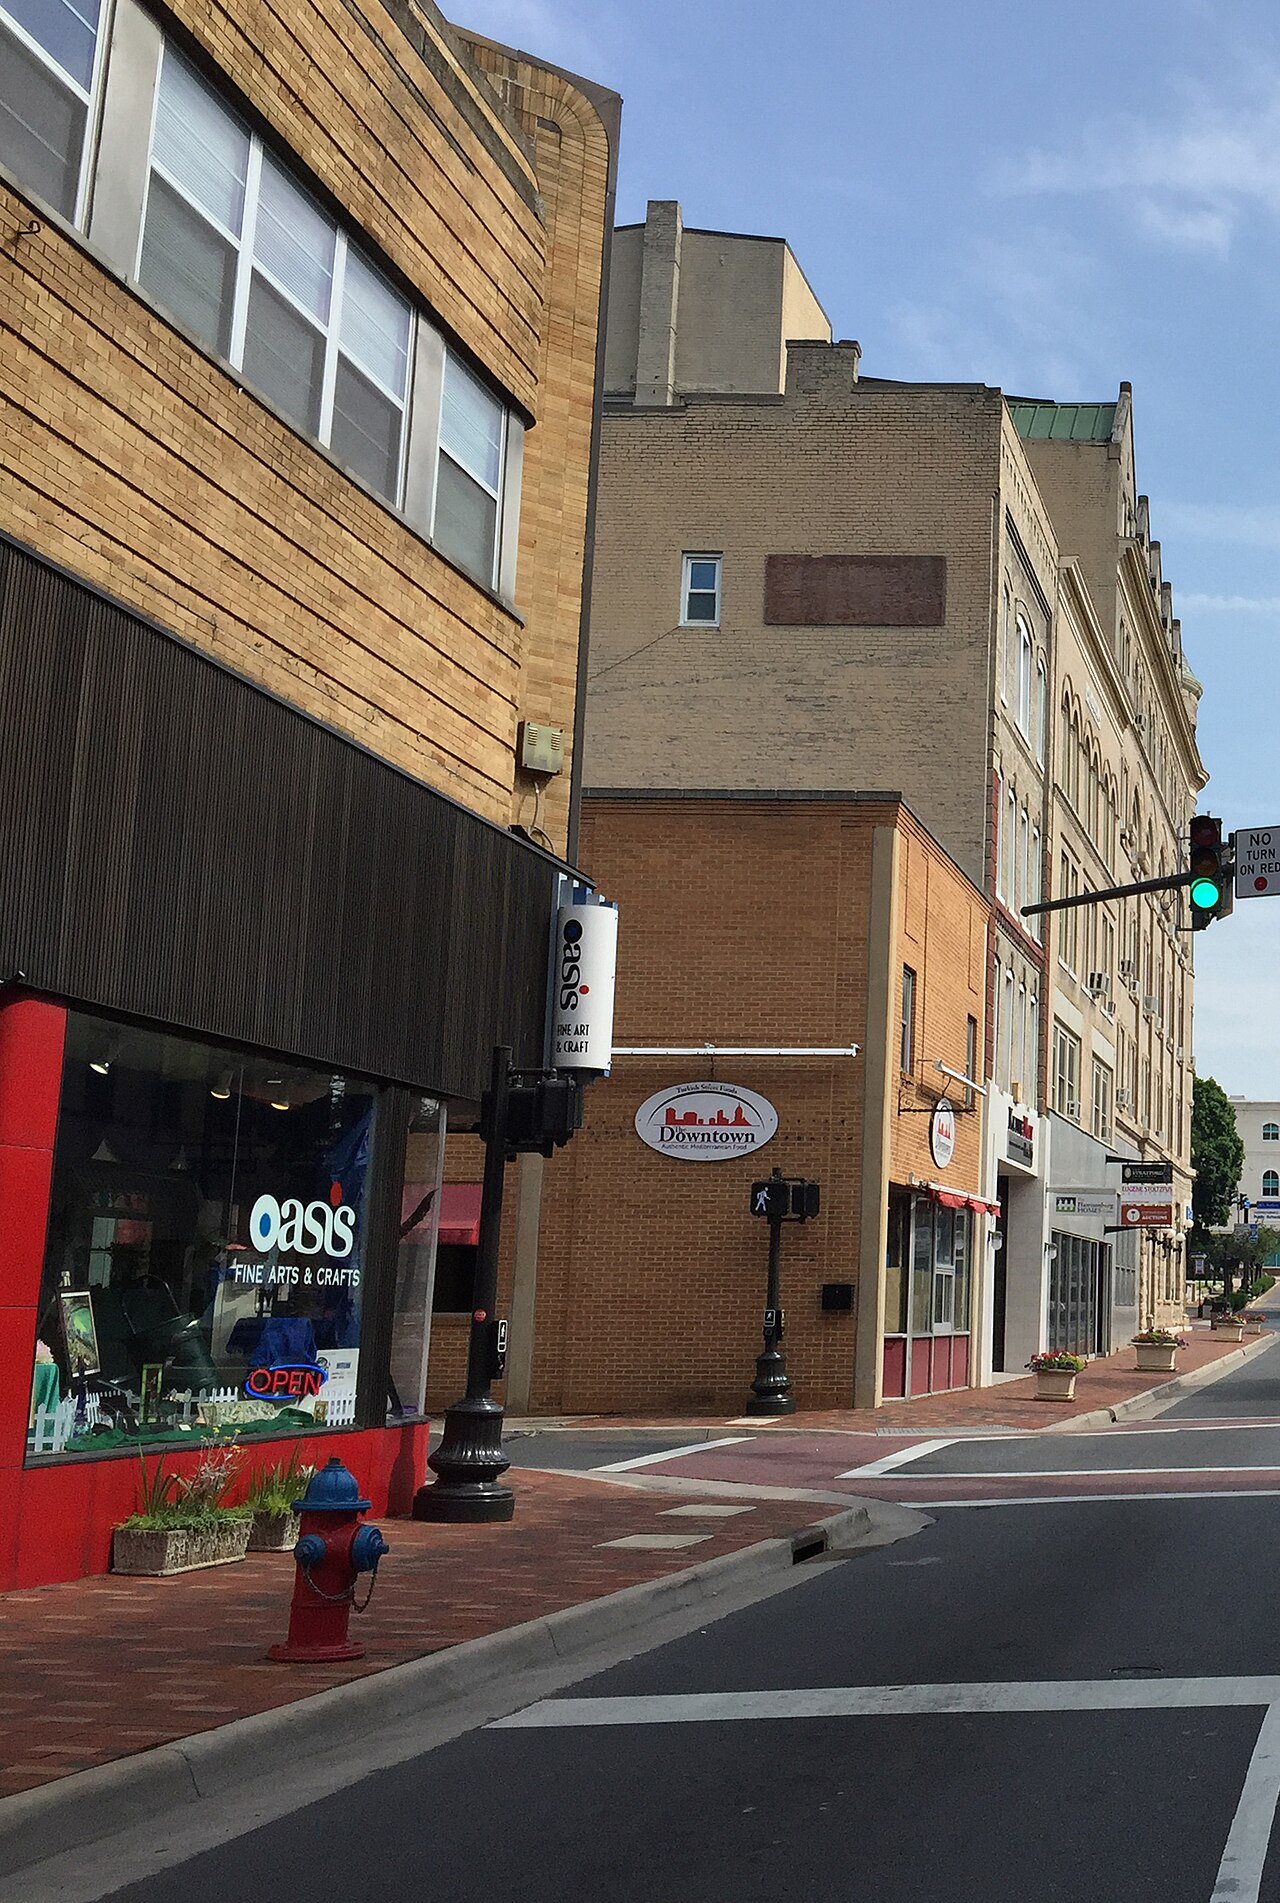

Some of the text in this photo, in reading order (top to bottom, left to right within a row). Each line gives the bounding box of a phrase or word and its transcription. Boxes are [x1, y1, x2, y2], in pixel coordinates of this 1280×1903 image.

[1250, 832, 1271, 847] NO
[1246, 848, 1276, 861] TURN
[1240, 864, 1255, 876] ON
[557, 1024, 590, 1037] FINE ART
[563, 1041, 589, 1053] CRAFT
[659, 1126, 756, 1143] Downtown
[234, 1264, 361, 1287] FINE ARTS & CRAFTS
[250, 1368, 322, 1396] OPEN
